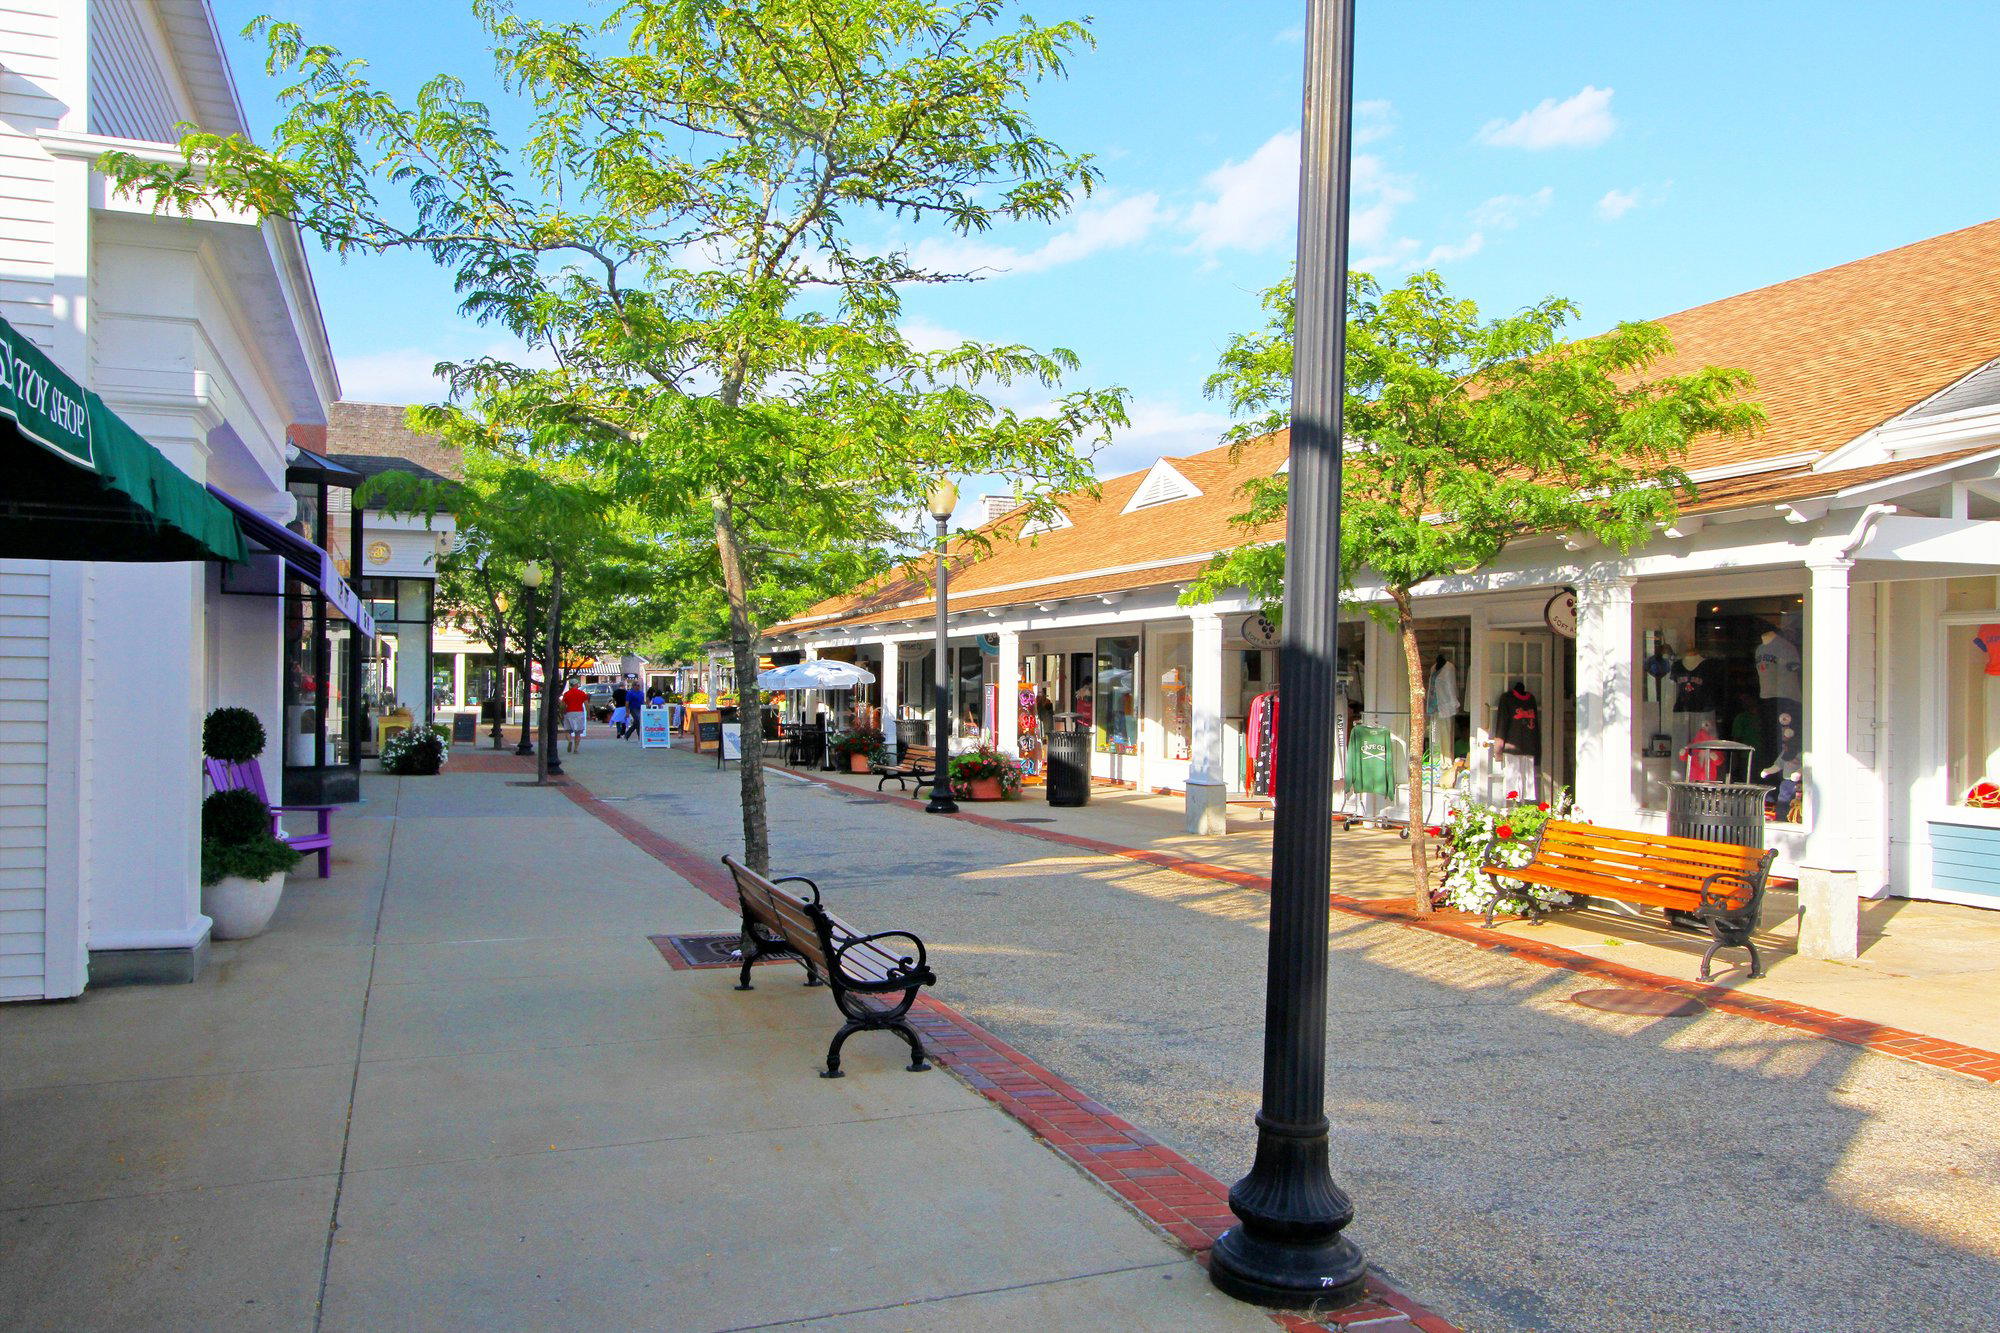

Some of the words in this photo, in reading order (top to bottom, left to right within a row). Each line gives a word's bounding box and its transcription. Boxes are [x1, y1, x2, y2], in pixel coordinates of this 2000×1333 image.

[14, 358, 49, 415] TOY
[50, 386, 85, 438] SHOP
[1553, 615, 1568, 631] SOFT
[1377, 744, 1386, 752] CO
[1320, 1276, 1334, 1287] 72
